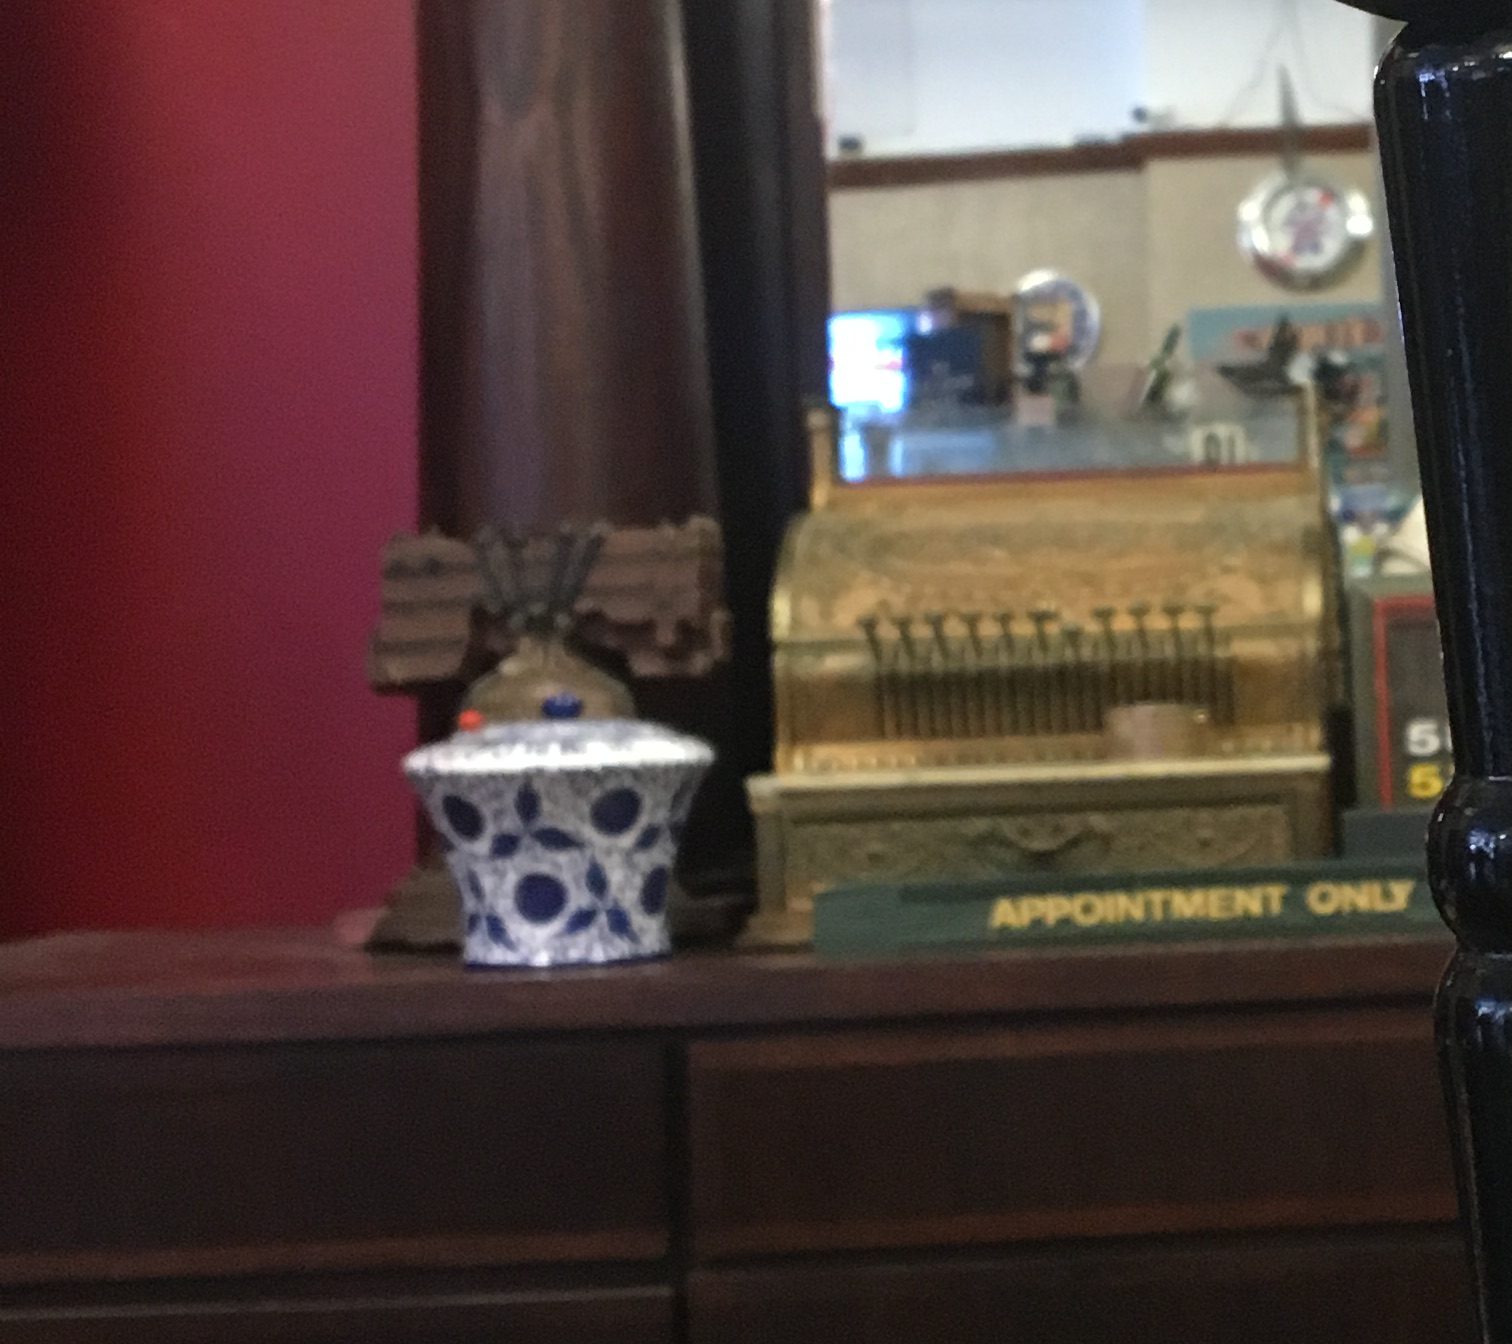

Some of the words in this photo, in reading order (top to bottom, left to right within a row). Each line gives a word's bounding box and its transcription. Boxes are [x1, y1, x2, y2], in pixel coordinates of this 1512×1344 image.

[1405, 719, 1454, 757] 5
[1406, 762, 1456, 800] 5
[987, 883, 1290, 931] APPOINTMENT
[1303, 878, 1417, 916] ONLY
